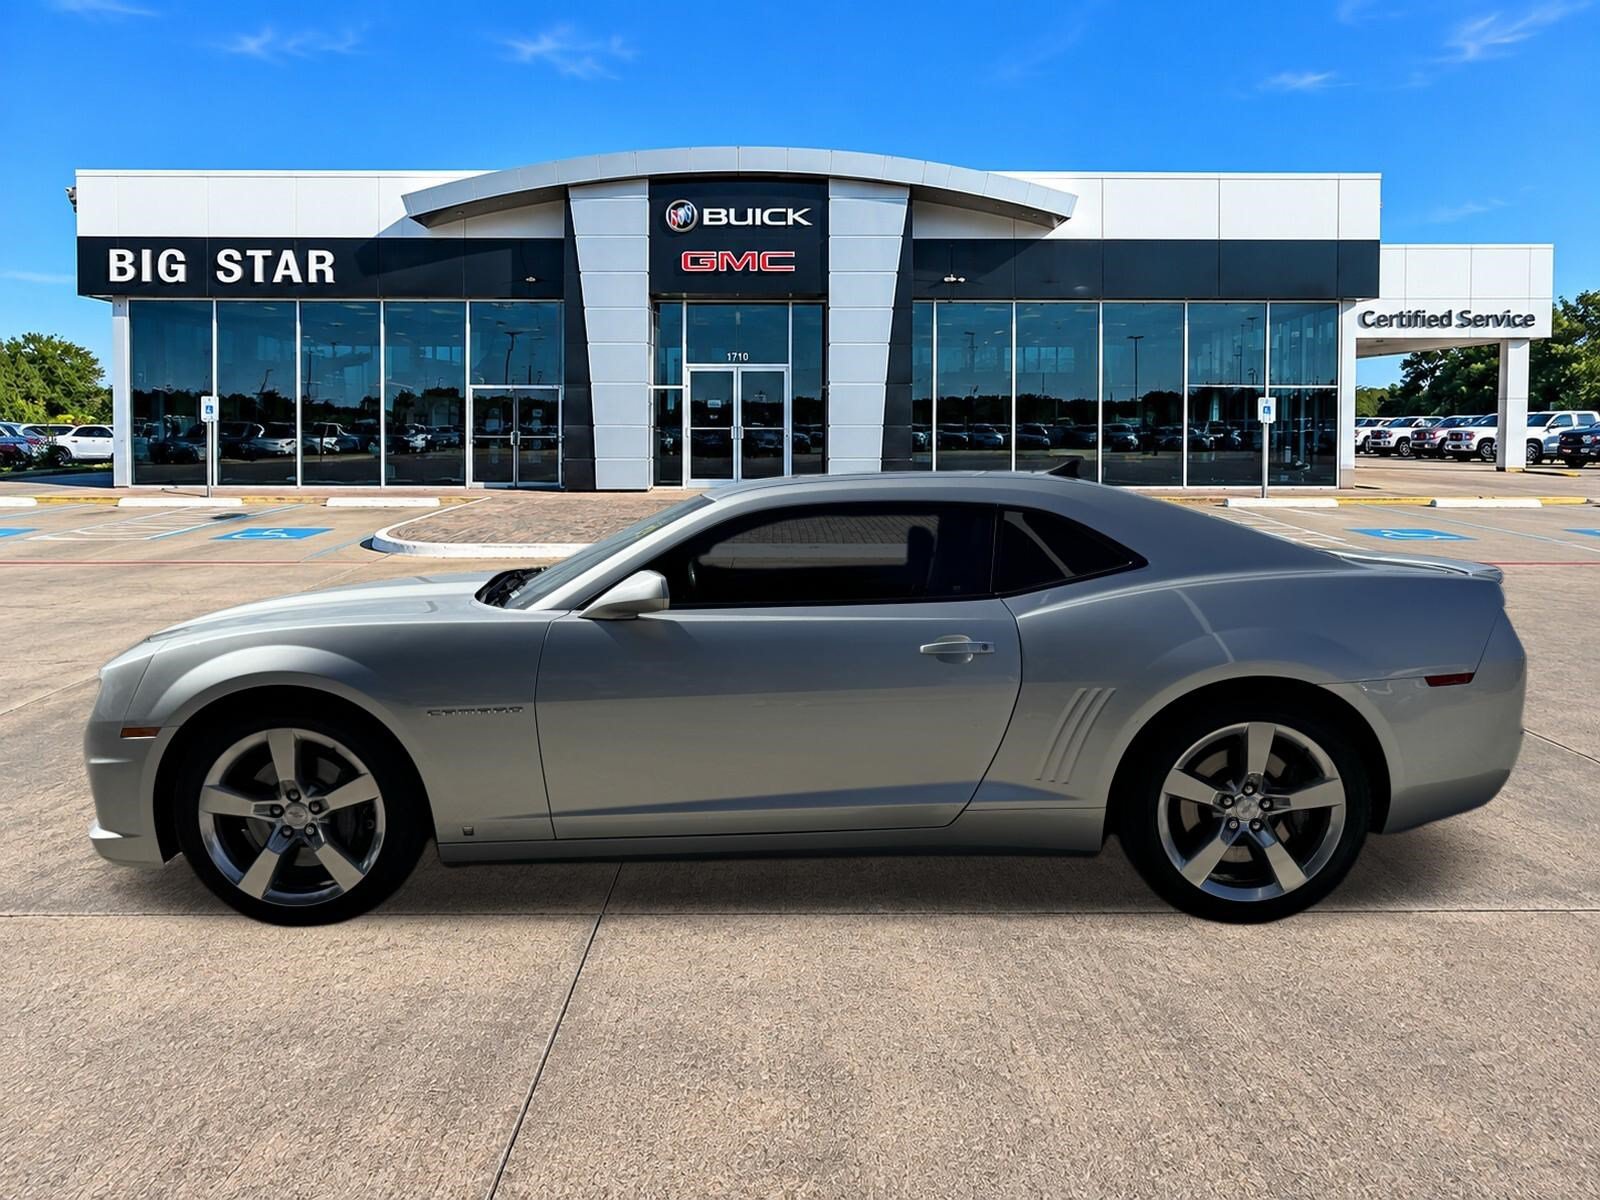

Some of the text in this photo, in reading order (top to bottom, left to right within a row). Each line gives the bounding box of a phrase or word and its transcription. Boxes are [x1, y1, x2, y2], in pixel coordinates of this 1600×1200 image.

[703, 208, 813, 226] BUICK
[109, 248, 335, 284] BIG STAR
[681, 250, 796, 272] GMC
[1360, 309, 1536, 328] Certified Service
[727, 352, 749, 361] 1710
